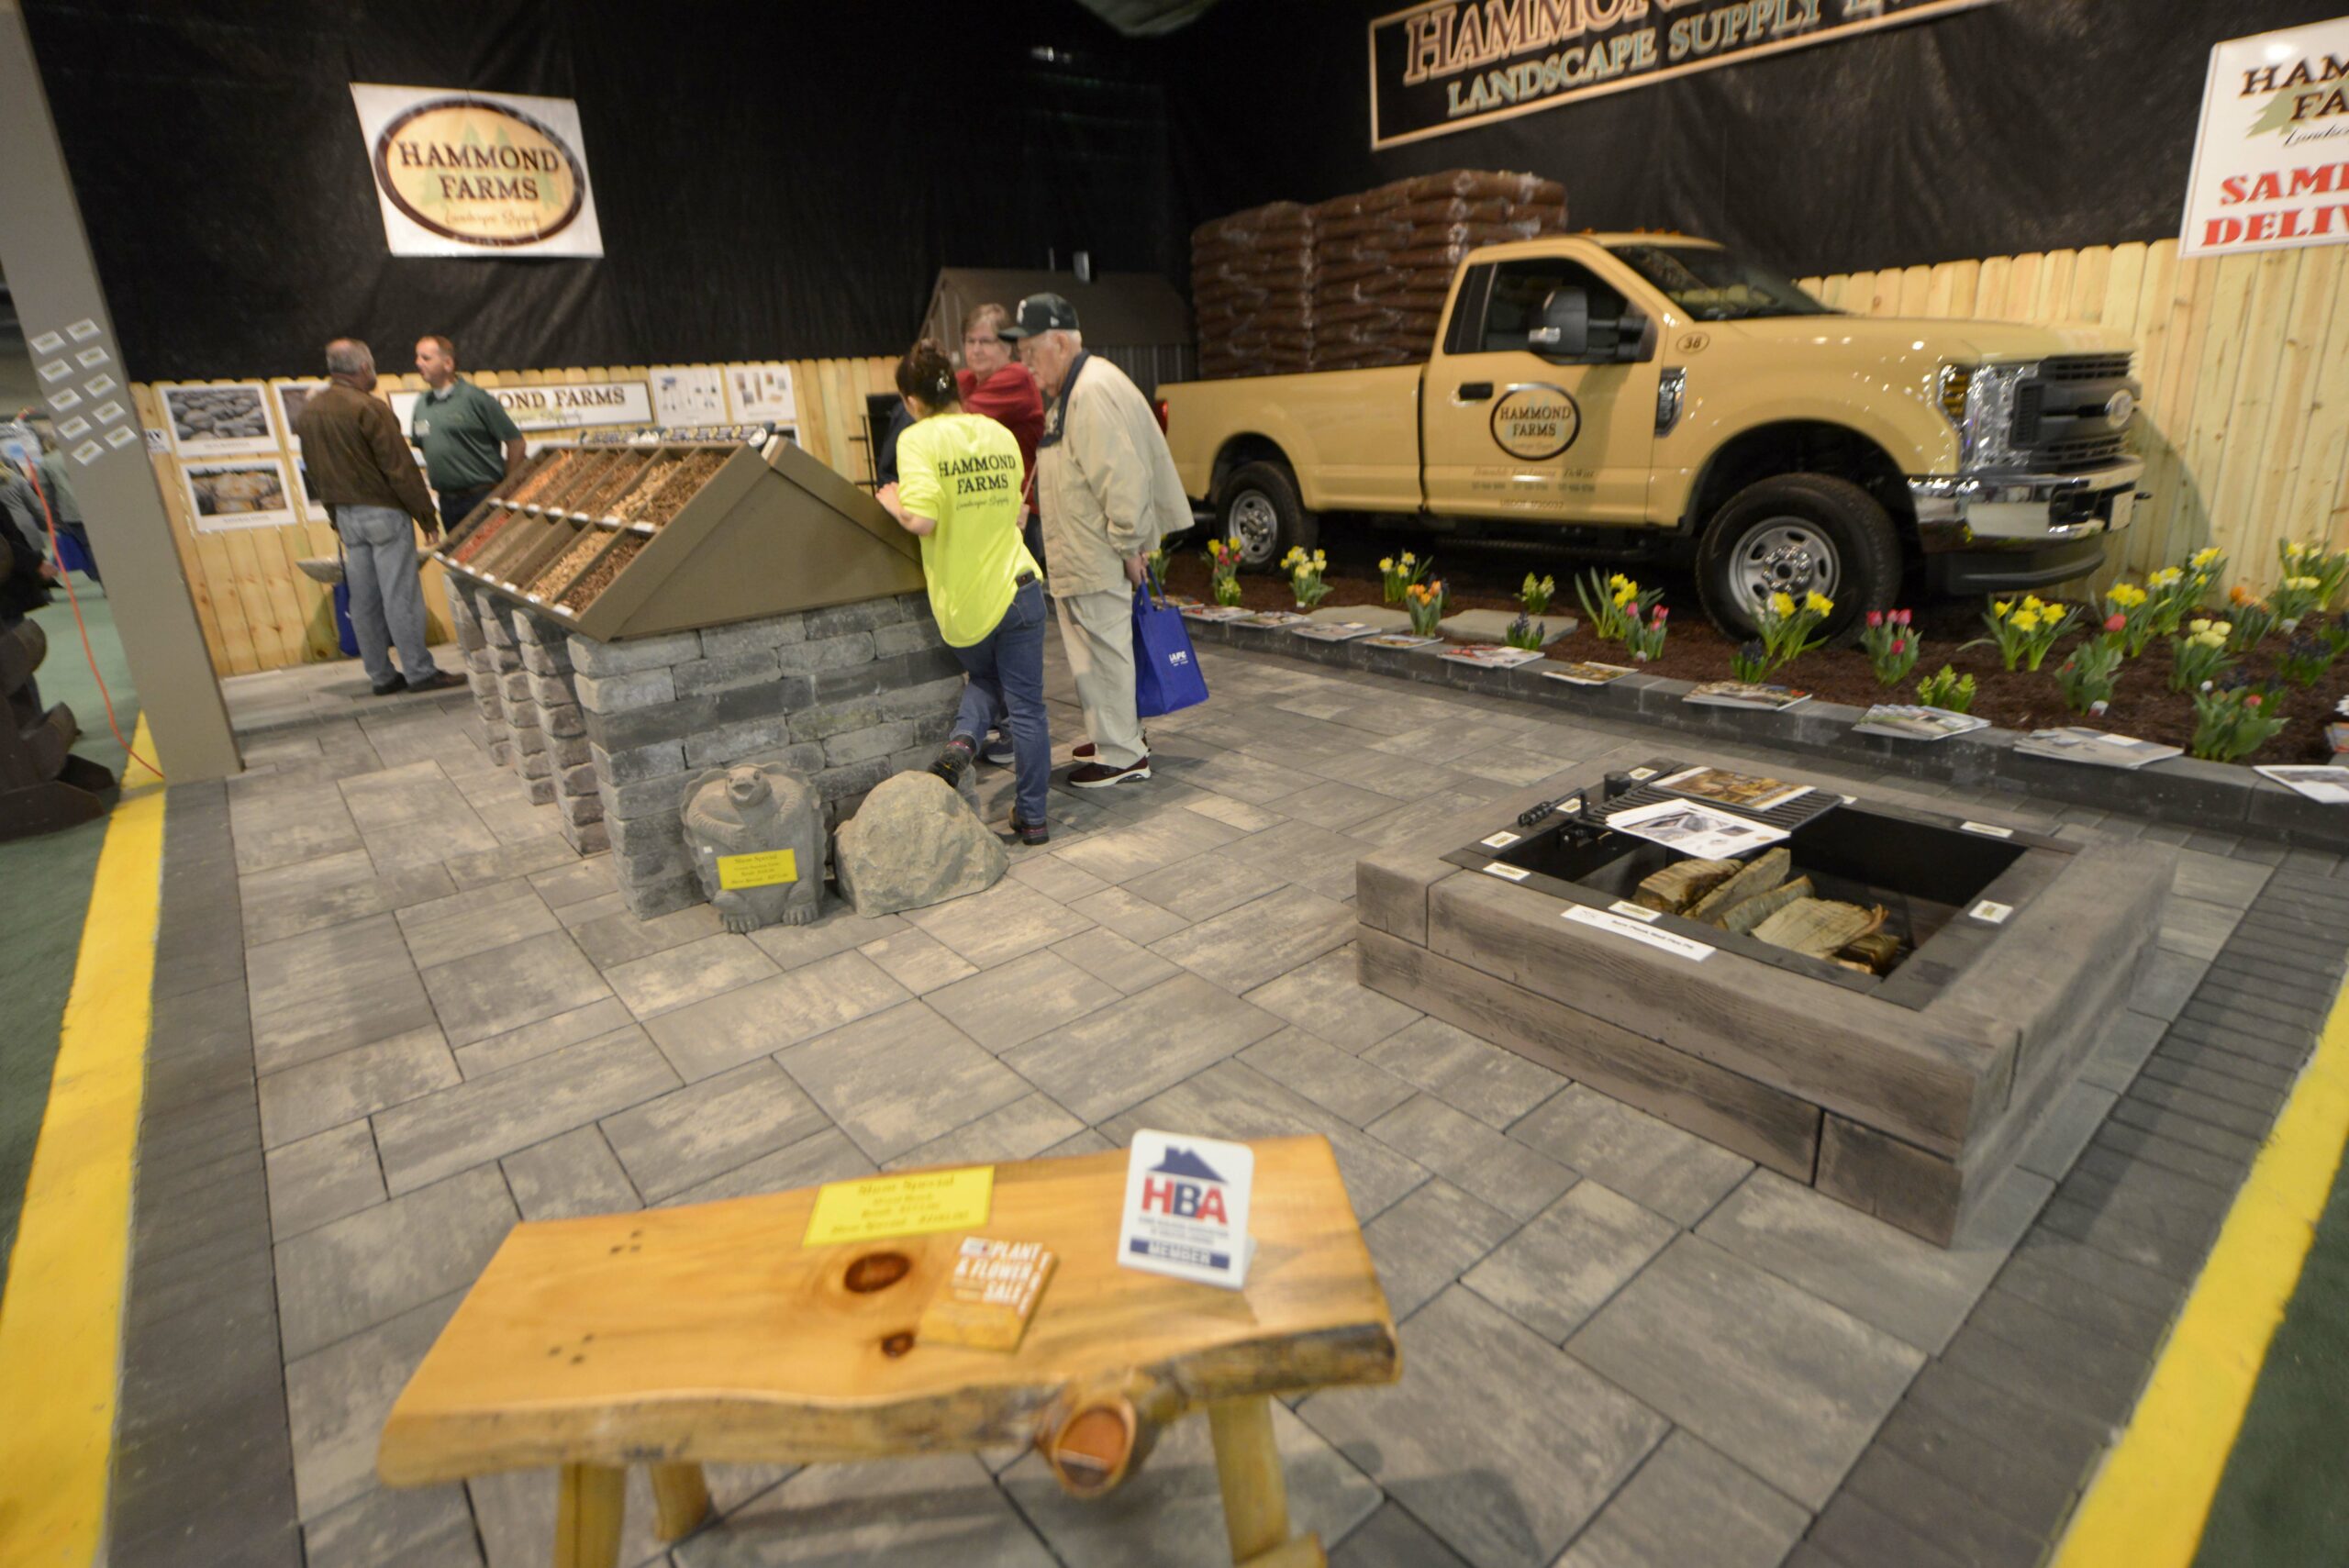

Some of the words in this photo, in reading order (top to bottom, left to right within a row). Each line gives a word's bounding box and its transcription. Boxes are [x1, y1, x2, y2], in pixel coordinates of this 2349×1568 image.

[1403, 0, 1698, 86] HAMMO
[1446, 27, 1657, 117] LANDSCAPE
[1667, 0, 1821, 61] SUPPLY
[397, 140, 560, 172] HAMMOND
[438, 174, 540, 201] FARMS
[555, 386, 626, 408] FARMS
[1499, 406, 1572, 421] HAMMOND
[1512, 423, 1557, 438] FARMS
[938, 454, 1016, 477] HAMMOND
[957, 473, 1009, 495] FARMS
[1141, 1175, 1228, 1227] HBA
[990, 1240, 1043, 1262] PLANT
[1148, 1239, 1210, 1265] MEMBER
[970, 1258, 1034, 1283] FLOWER
[982, 1280, 1025, 1306] SALE
